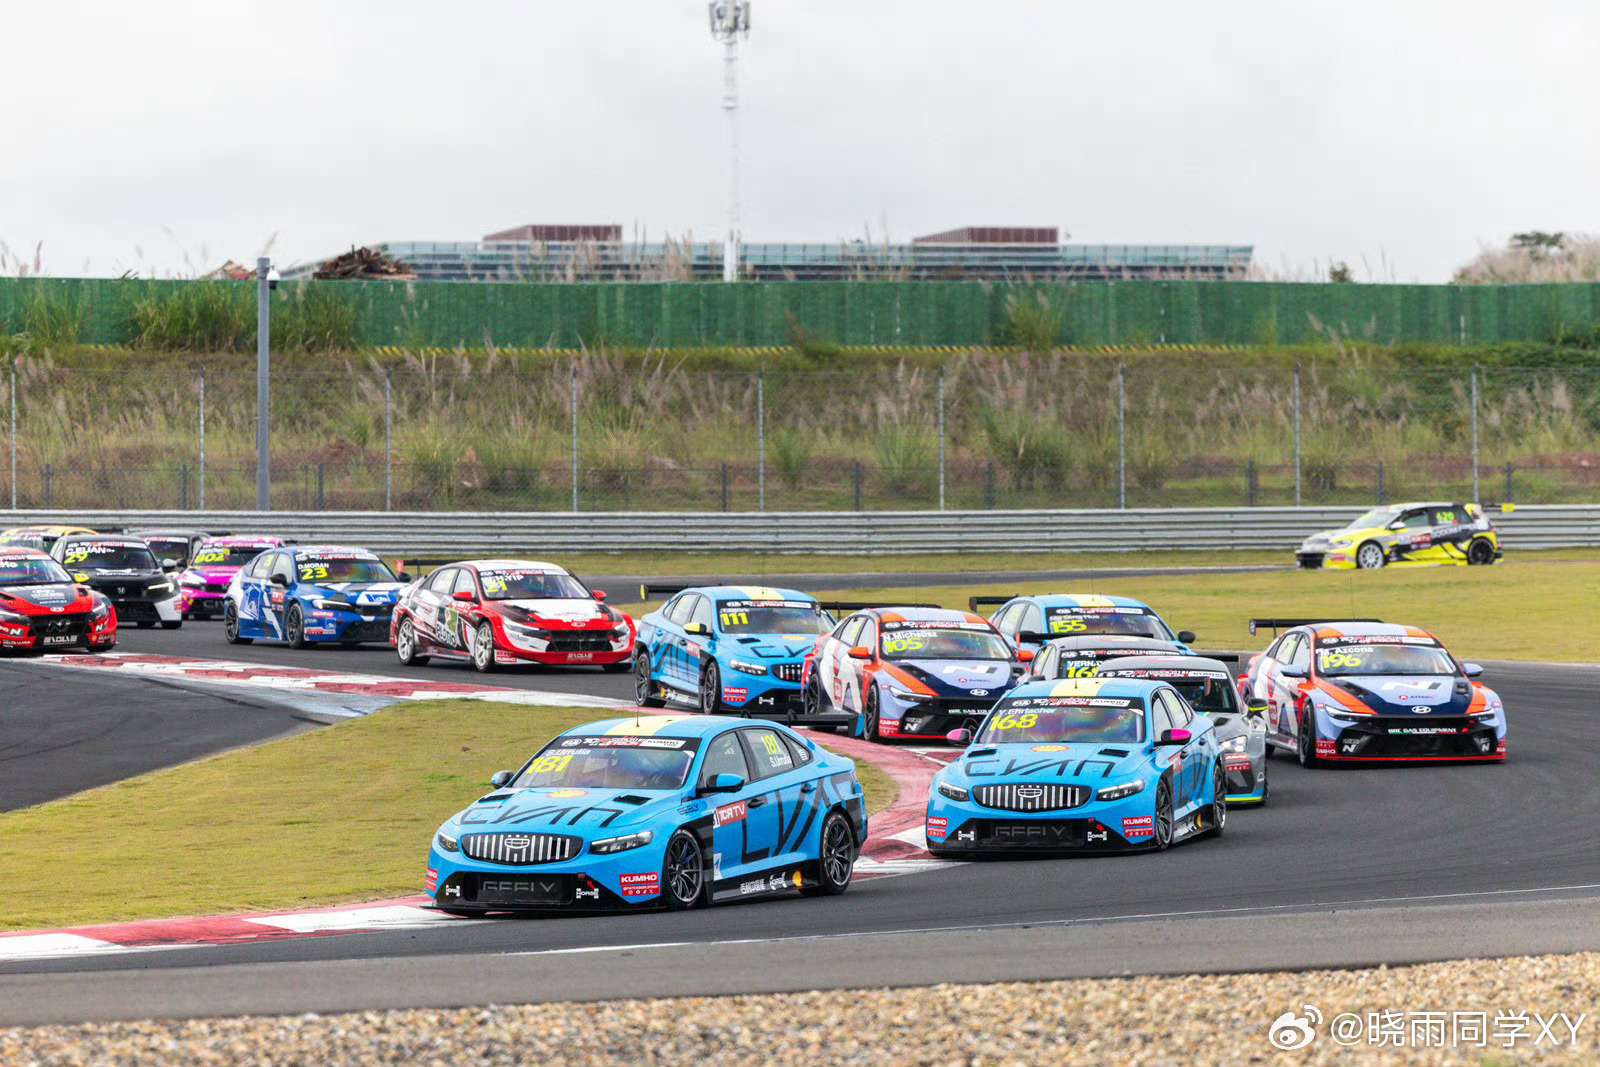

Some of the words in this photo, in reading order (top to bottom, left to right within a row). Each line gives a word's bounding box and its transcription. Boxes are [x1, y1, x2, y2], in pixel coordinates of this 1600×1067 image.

[63, 553, 89, 565] 29
[301, 567, 329, 581] 23
[719, 612, 749, 626] 111
[1049, 619, 1088, 633] 155
[883, 637, 923, 653] 105
[1321, 653, 1362, 669] 196
[989, 713, 1039, 733] 168
[760, 734, 783, 755] 181
[525, 755, 575, 775] 181
[1123, 817, 1152, 826] KUMHO
[620, 873, 658, 883] KUMHO
